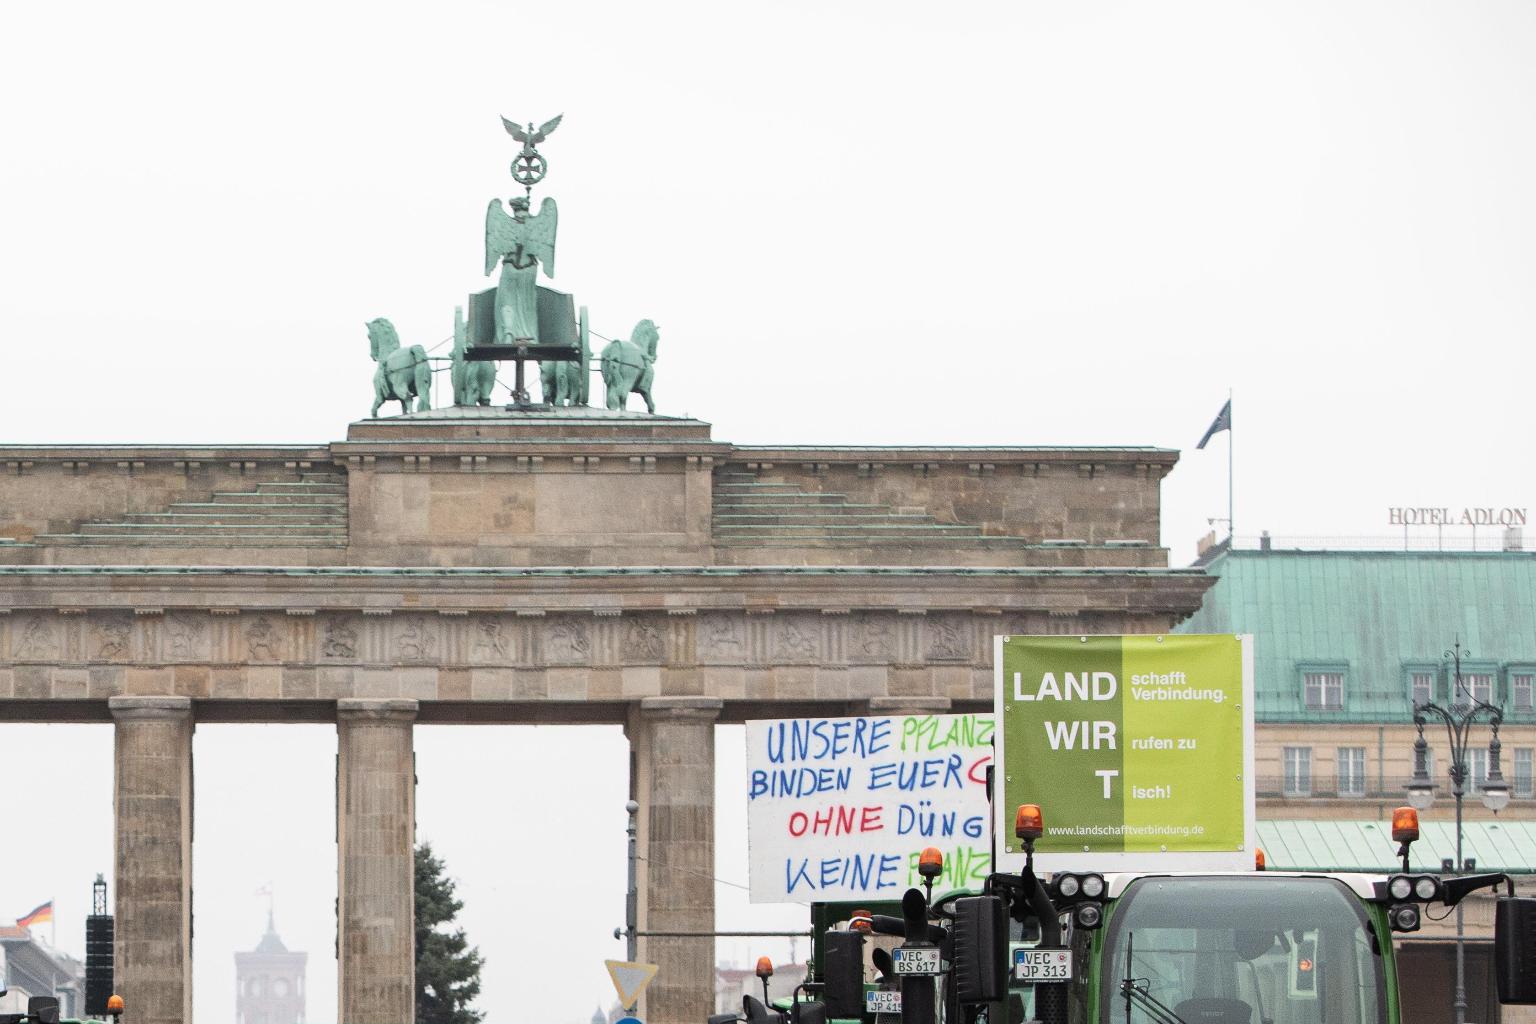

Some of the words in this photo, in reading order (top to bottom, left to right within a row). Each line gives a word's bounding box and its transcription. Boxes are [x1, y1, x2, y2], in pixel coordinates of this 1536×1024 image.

[1389, 507, 1453, 525] HOTEL
[1459, 507, 1527, 525] ADLON
[1013, 671, 1118, 701] LAND
[1131, 671, 1186, 686] schafft
[1131, 687, 1228, 703] Verbindung.
[767, 718, 892, 764] UNSERE
[1044, 720, 1117, 750] WIR
[1131, 735, 1174, 750] rufen
[1177, 738, 1197, 750] zu
[749, 766, 852, 800] BINDEN
[866, 753, 963, 792] EUER
[1094, 769, 1119, 799] T
[1131, 784, 1172, 799] isch!
[788, 804, 884, 838] OHNE
[896, 801, 984, 839] DÜNG
[1047, 823, 1205, 837] www.landschafftverbindung.de
[786, 853, 902, 894] KEINE
[901, 951, 923, 962] VEC
[1025, 952, 1051, 965] VEC
[898, 962, 913, 972] BS
[915, 962, 936, 972] 617
[1022, 965, 1039, 977] JP
[1042, 965, 1067, 977] 313
[874, 993, 893, 1002] VEC
[871, 1002, 883, 1011] JP
